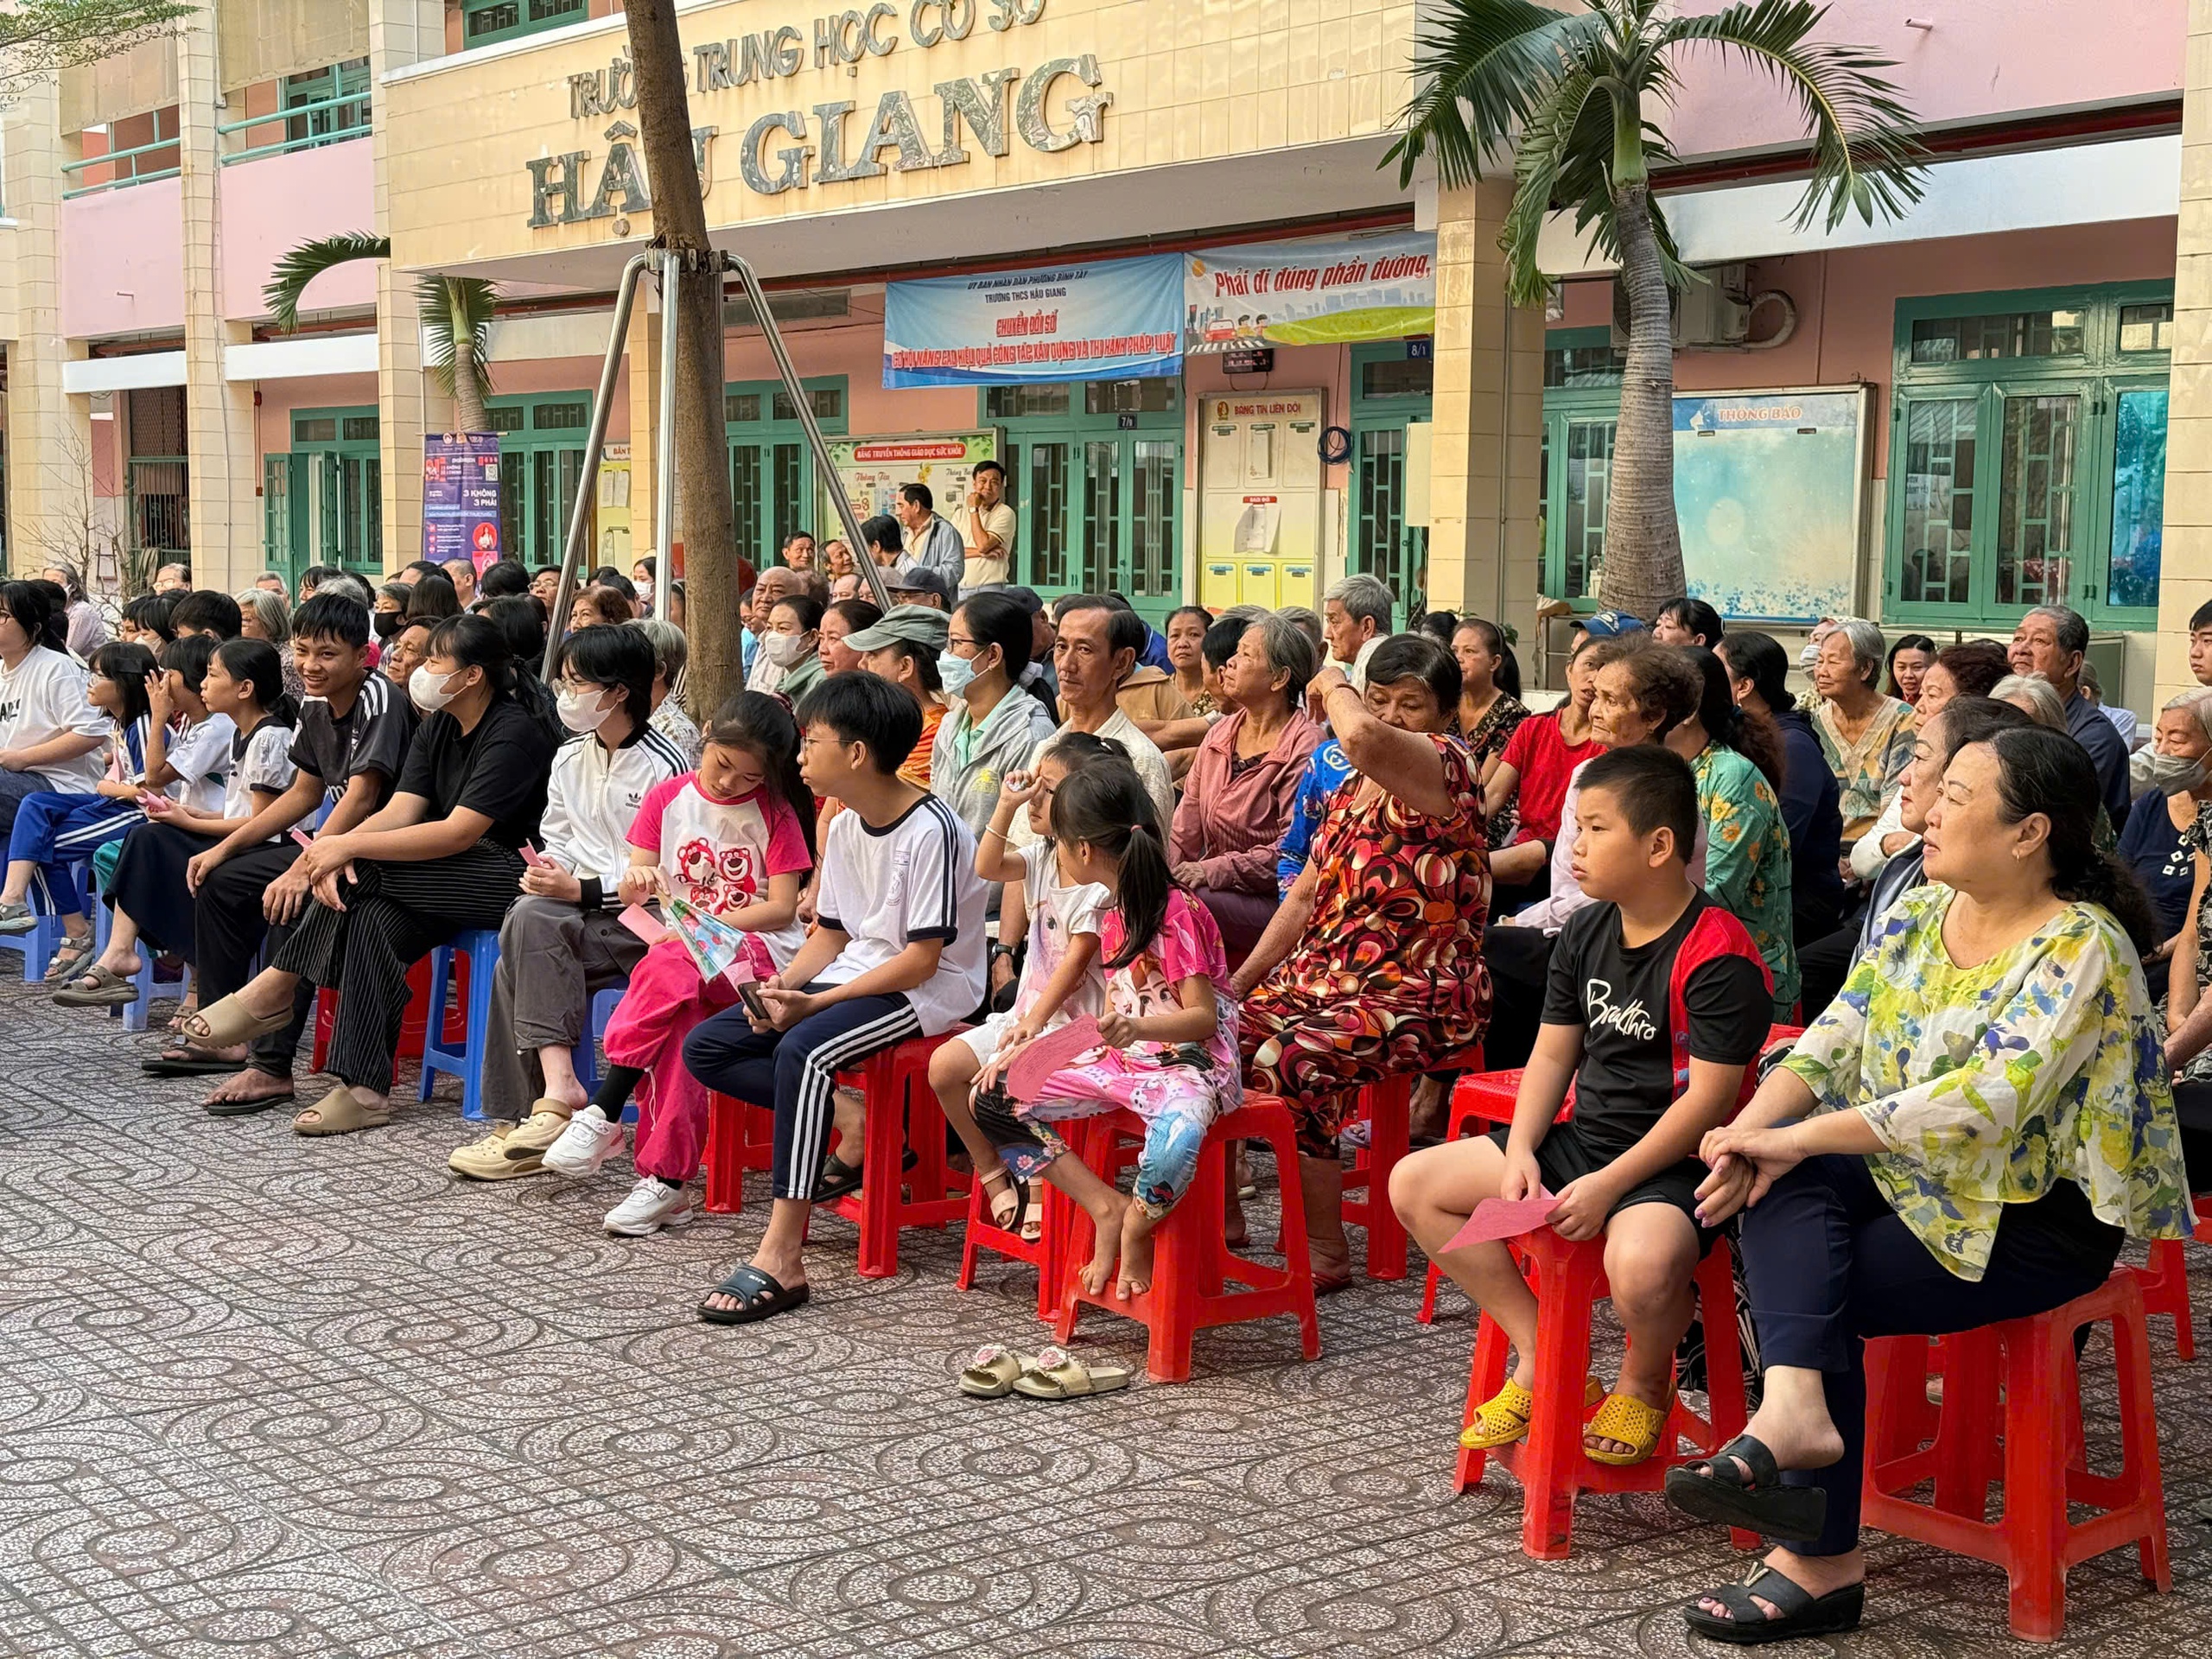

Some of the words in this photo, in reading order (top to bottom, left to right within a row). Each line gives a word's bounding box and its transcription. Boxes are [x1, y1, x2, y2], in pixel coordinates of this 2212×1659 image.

[693, 26, 804, 92] TRUNG
[814, 3, 899, 77] HỌC
[741, 54, 1113, 194] GIANG
[977, 281, 993, 289] BAN
[1214, 267, 1249, 297] Phải
[1253, 268, 1272, 294] đi
[1274, 265, 1319, 291] đúng
[1320, 255, 1369, 290] phần
[1012, 291, 1028, 301] THCS
[1030, 288, 1044, 301] HẬU
[1046, 287, 1067, 297] GIANG
[996, 310, 1028, 337] CHUYỂN
[993, 344, 1016, 365] CÔNG
[1127, 332, 1154, 355] PHÁP
[1256, 404, 1268, 413] TIN
[1718, 406, 1769, 422] THÔNG
[1771, 404, 1802, 421] BÁO
[471, 487, 497, 498] KHÔNG
